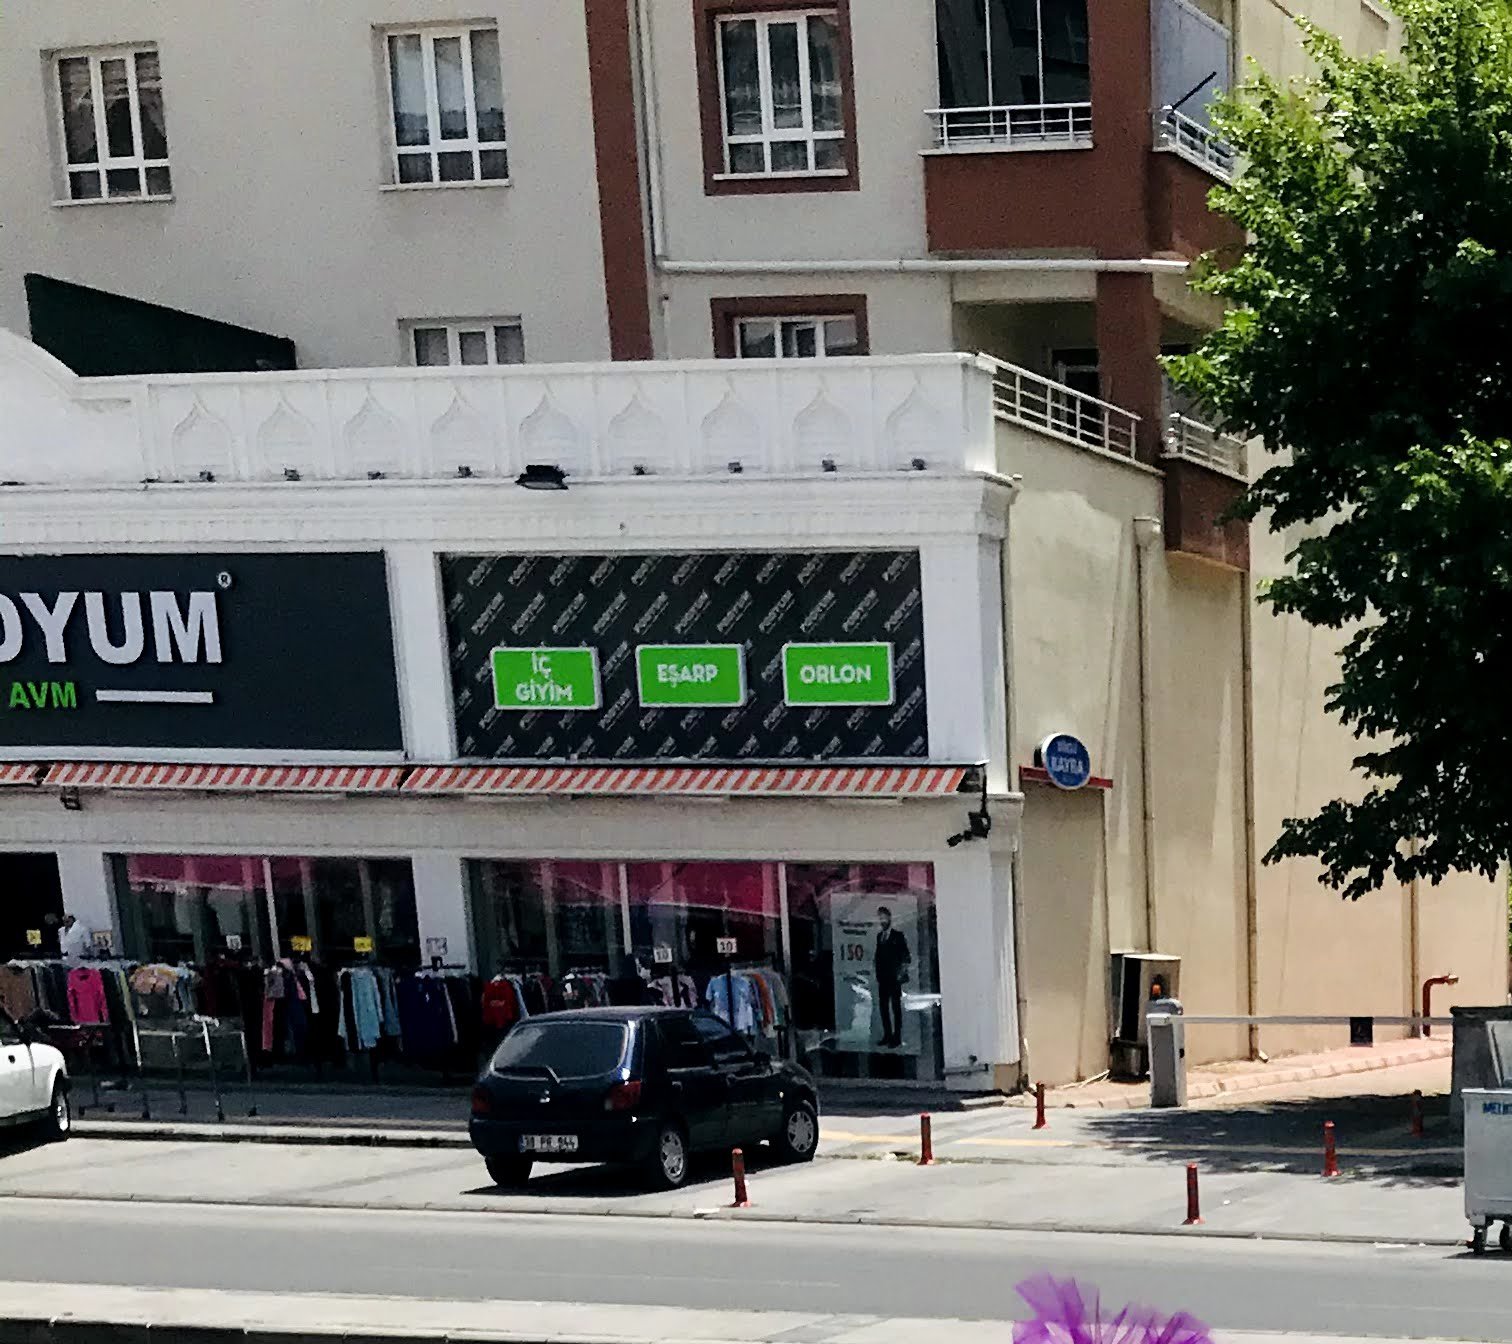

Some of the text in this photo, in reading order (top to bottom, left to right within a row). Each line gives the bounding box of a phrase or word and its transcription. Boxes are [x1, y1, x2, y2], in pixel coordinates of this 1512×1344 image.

[531, 652, 552, 678] İÇ
[656, 664, 718, 688] EŞARP
[800, 664, 872, 684] ORLON
[9, 682, 77, 709] AVM
[515, 680, 573, 702] GİYİM
